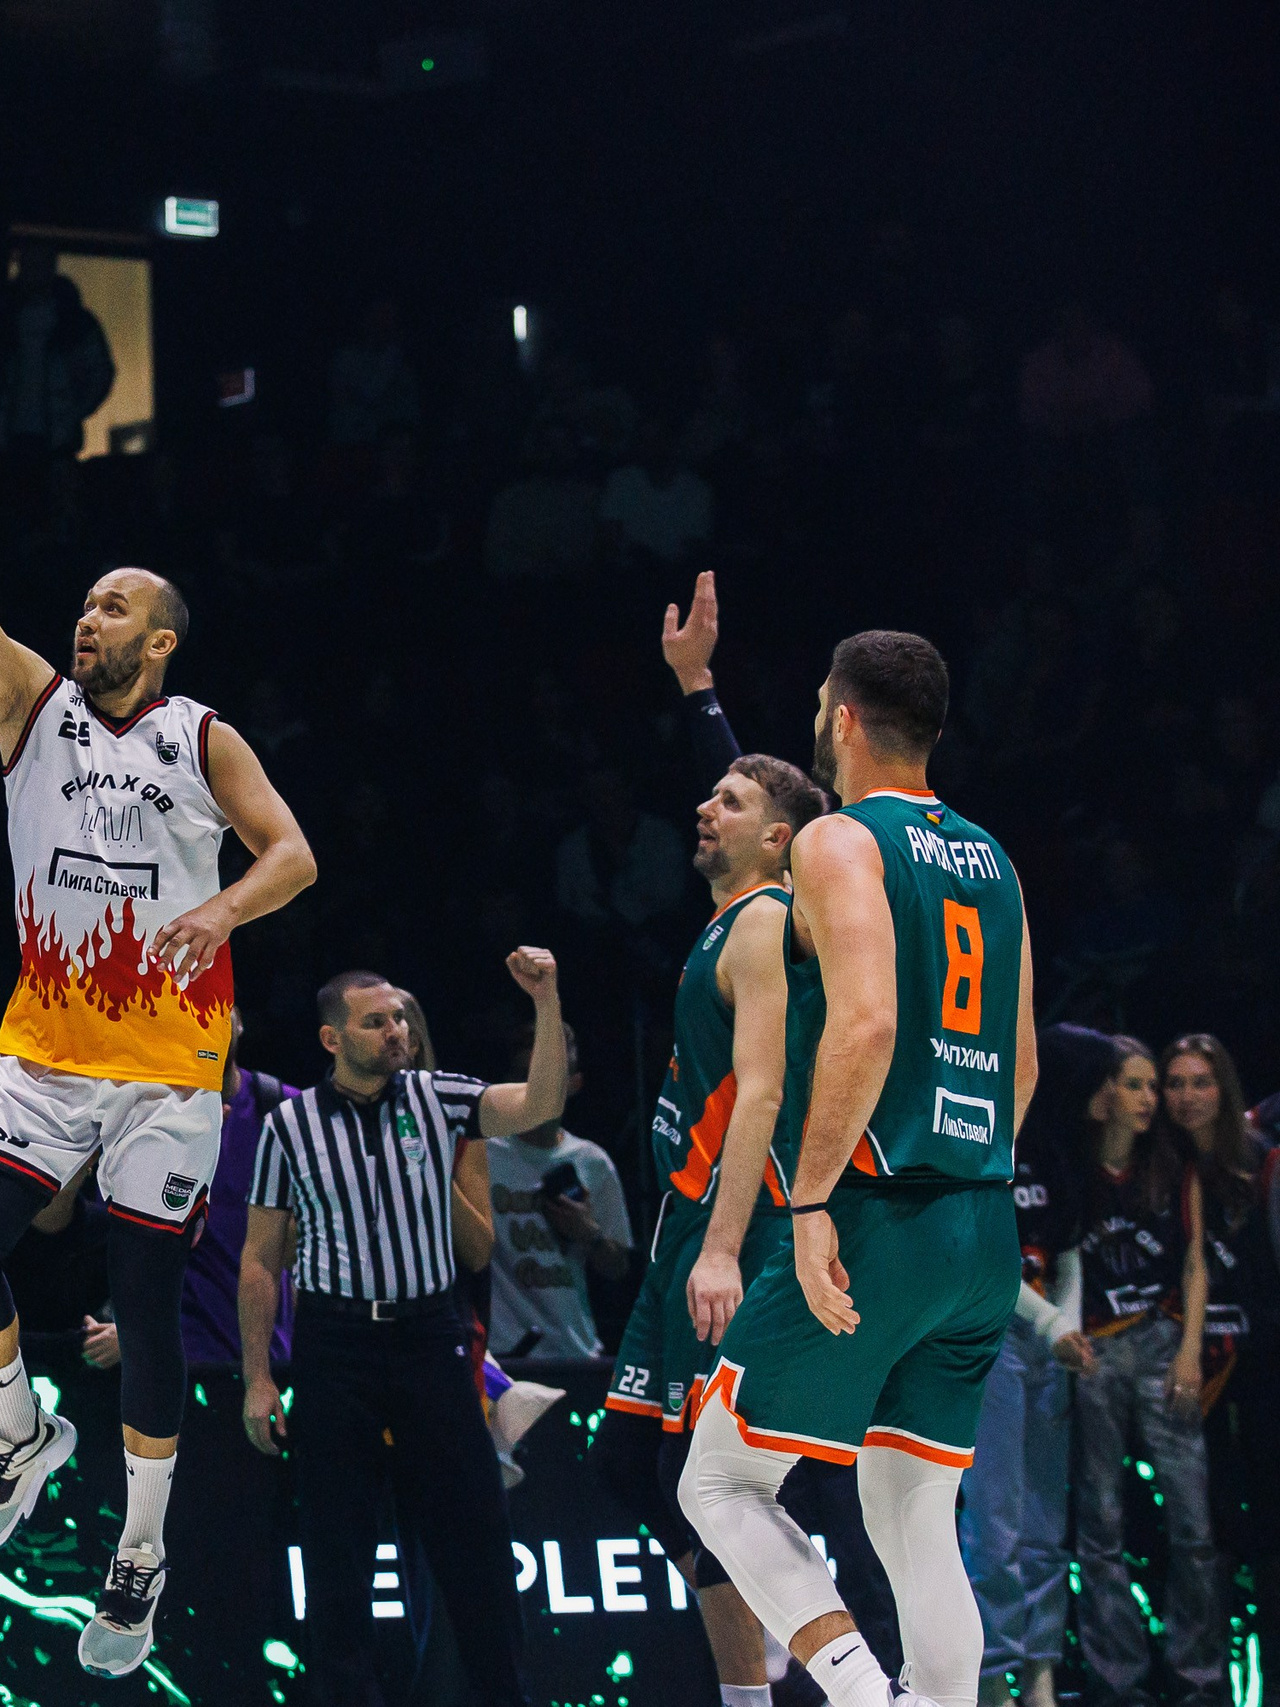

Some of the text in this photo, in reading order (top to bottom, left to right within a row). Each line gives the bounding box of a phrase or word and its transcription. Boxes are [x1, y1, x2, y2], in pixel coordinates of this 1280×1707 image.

[58, 869, 148, 900] ЛИГА СТАВОК
[941, 898, 983, 1036] 8
[618, 1365, 650, 1396] 22
